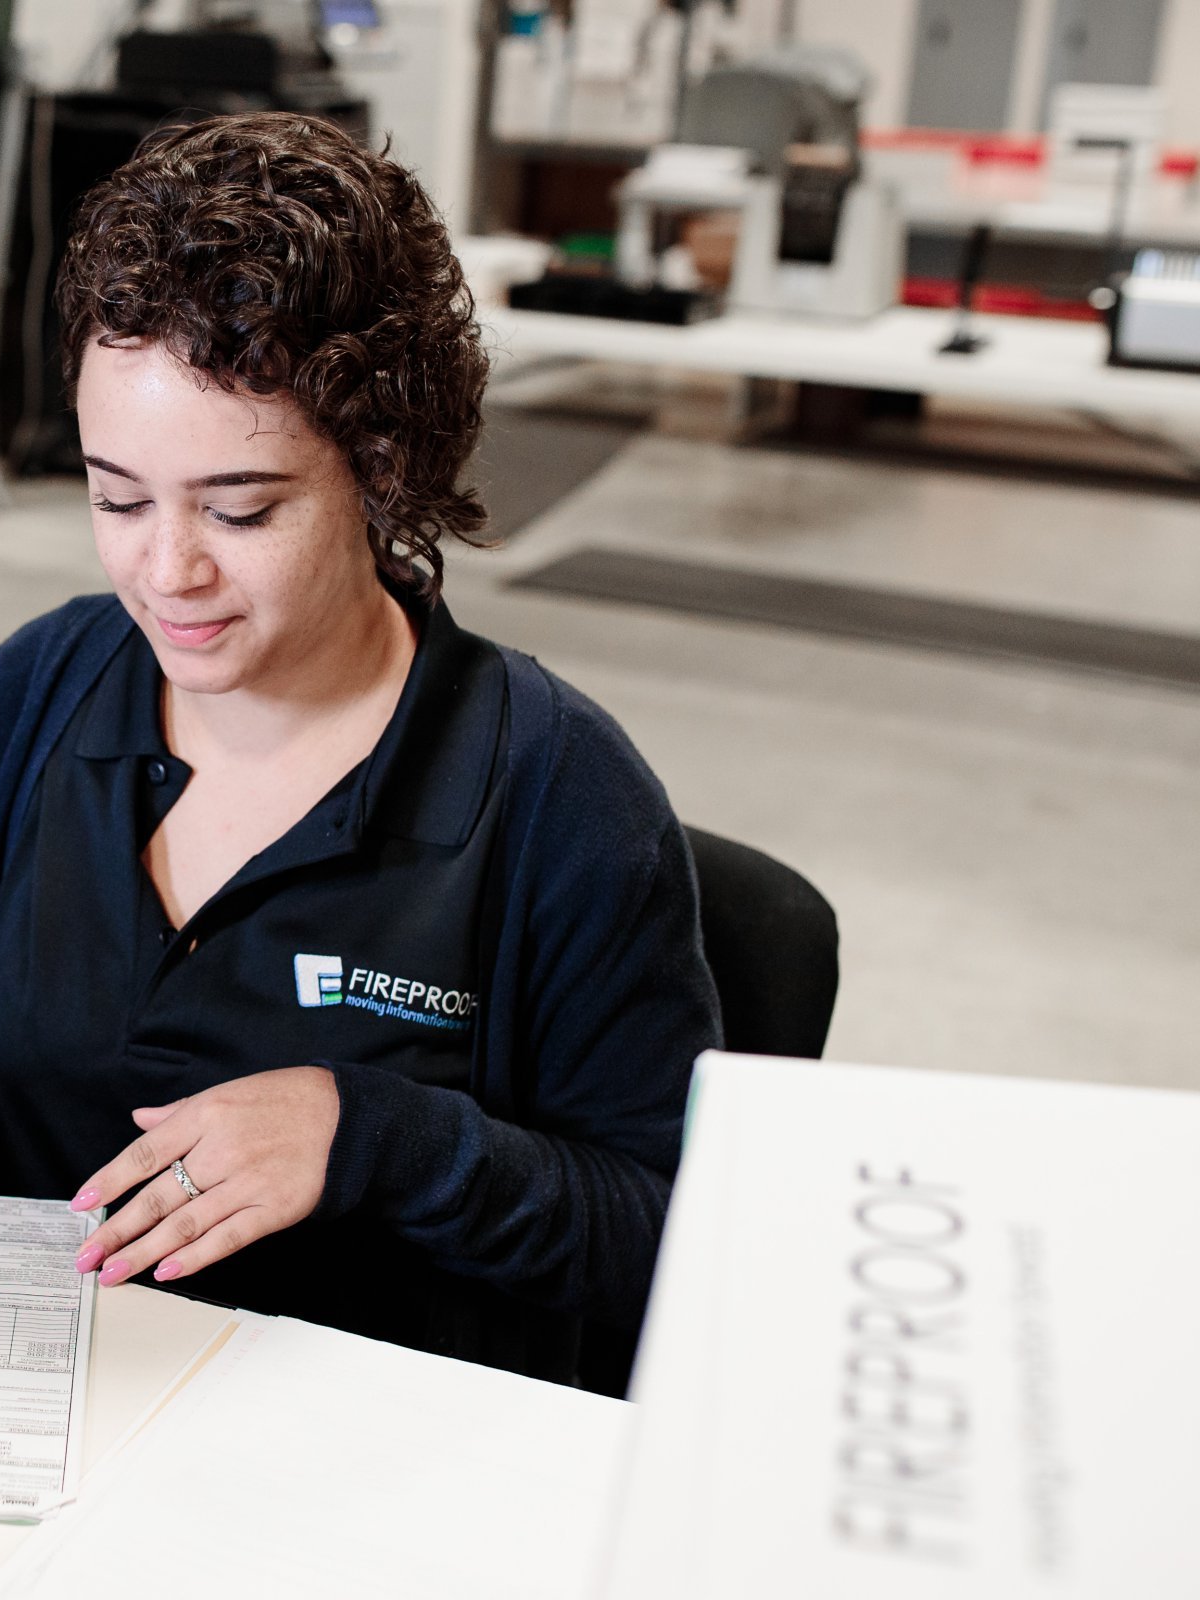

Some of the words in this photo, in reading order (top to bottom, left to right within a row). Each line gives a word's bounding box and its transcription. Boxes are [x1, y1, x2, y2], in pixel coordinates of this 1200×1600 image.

[345, 994, 386, 1016] moving
[348, 968, 479, 1016] FIREPROOF
[830, 1159, 978, 1570] FIREPROOF
